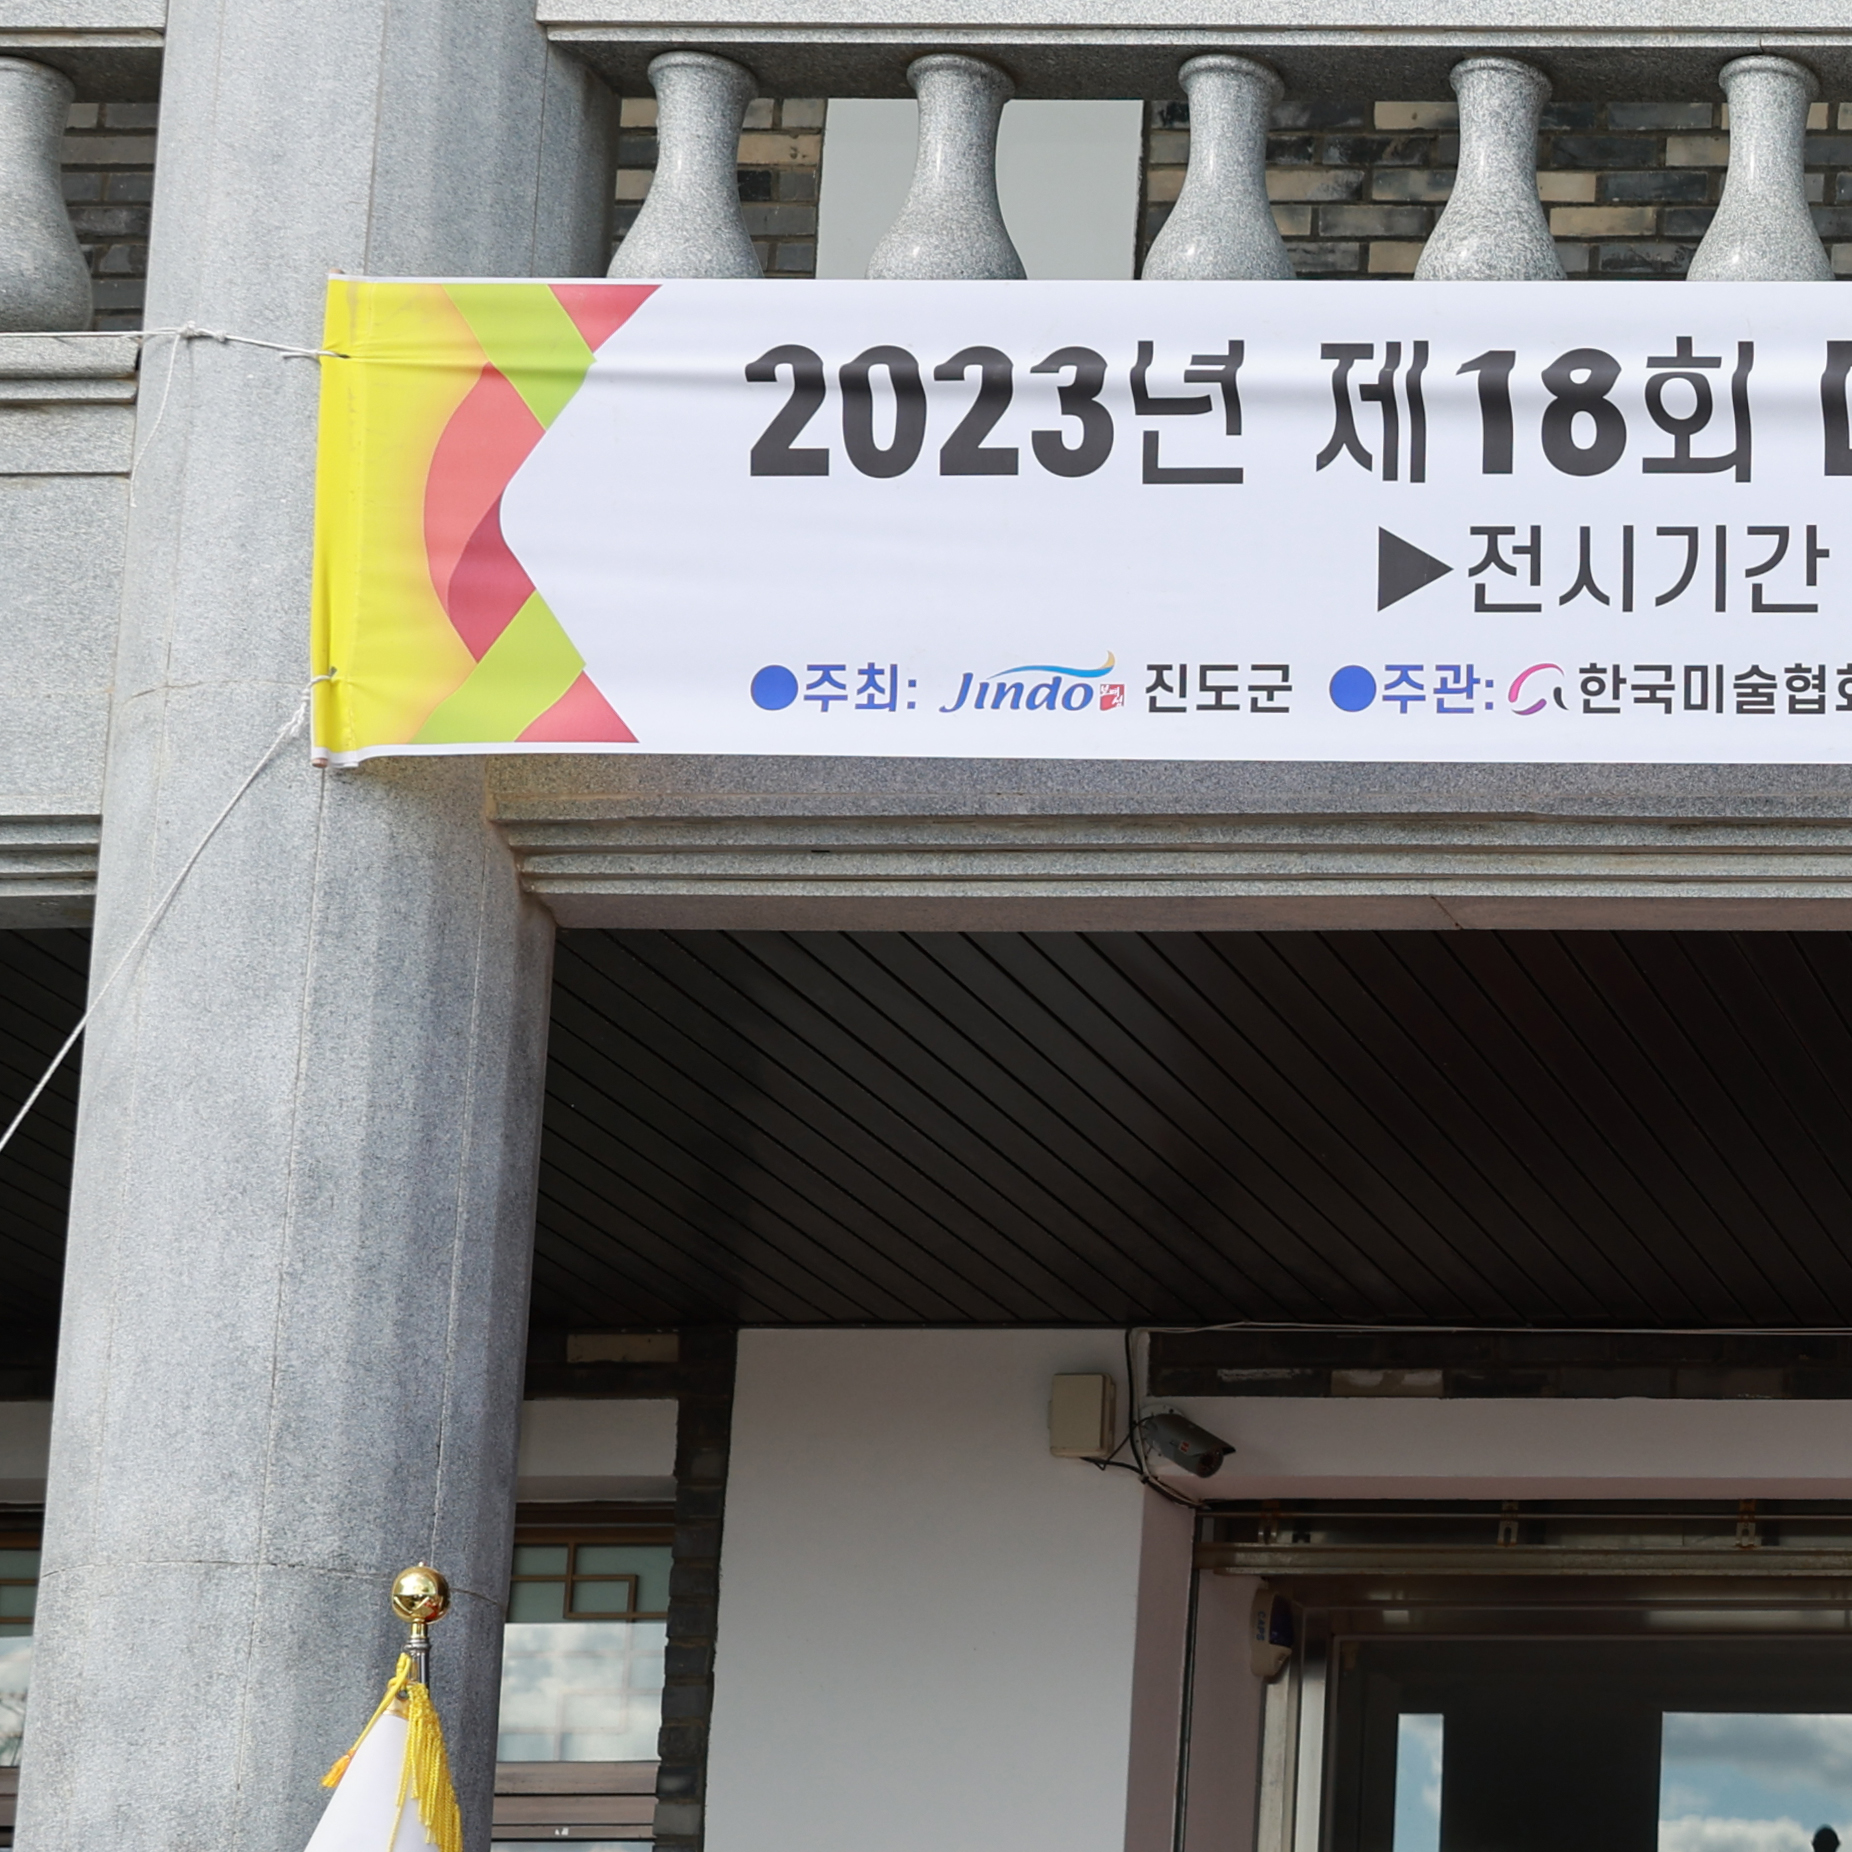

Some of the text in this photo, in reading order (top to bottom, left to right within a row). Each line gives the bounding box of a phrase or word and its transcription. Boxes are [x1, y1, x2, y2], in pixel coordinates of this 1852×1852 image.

[745, 340, 1244, 484] 2023년
[1316, 336, 1754, 483] 제18회
[1469, 525, 1829, 612] 전시기간
[805, 663, 917, 713] 주최:
[938, 668, 1096, 714] Jindo
[1145, 664, 1293, 714] 진도군
[1379, 663, 1494, 714] 주관:
